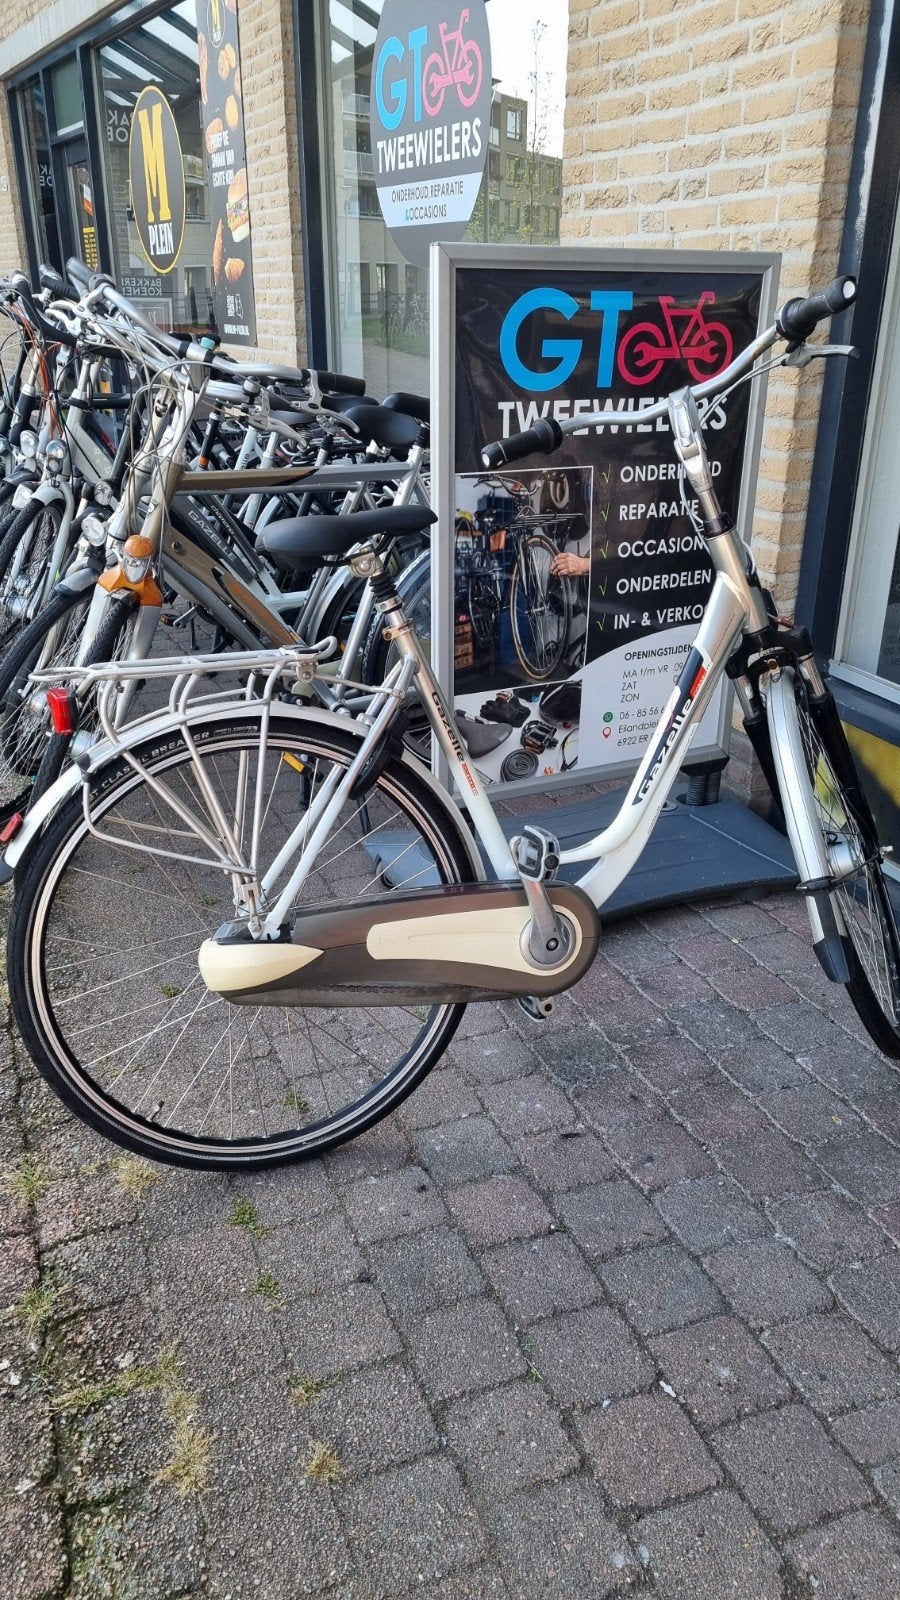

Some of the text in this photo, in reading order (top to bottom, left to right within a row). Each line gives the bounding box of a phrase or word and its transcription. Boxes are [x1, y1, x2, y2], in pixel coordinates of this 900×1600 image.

[376, 25, 428, 131] GT
[376, 117, 482, 174] TWEEWIELERS
[138, 103, 172, 222] M
[148, 222, 175, 256] PLEIN
[500, 287, 634, 392] GT
[620, 461, 721, 483] ONDERHD
[619, 499, 700, 521] REPARATIE
[188, 510, 237, 562] GAZELLE
[616, 568, 712, 595] ONDERDELEN
[614, 614, 636, 629] IN-
[641, 612, 651, 626] &
[622, 669, 637, 679] MA
[640, 666, 656, 676] t/m
[658, 665, 669, 674] VR
[620, 693, 640, 703] ZON
[621, 681, 637, 691] ZAT
[431, 691, 465, 762] Gazelle
[619, 710, 630, 720] 06
[636, 708, 648, 718] 85
[649, 707, 660, 716] 56
[151, 732, 210, 758] BREAER
[617, 736, 637, 747] 6922
[638, 734, 649, 744] ER
[638, 697, 692, 800] Gazelle
